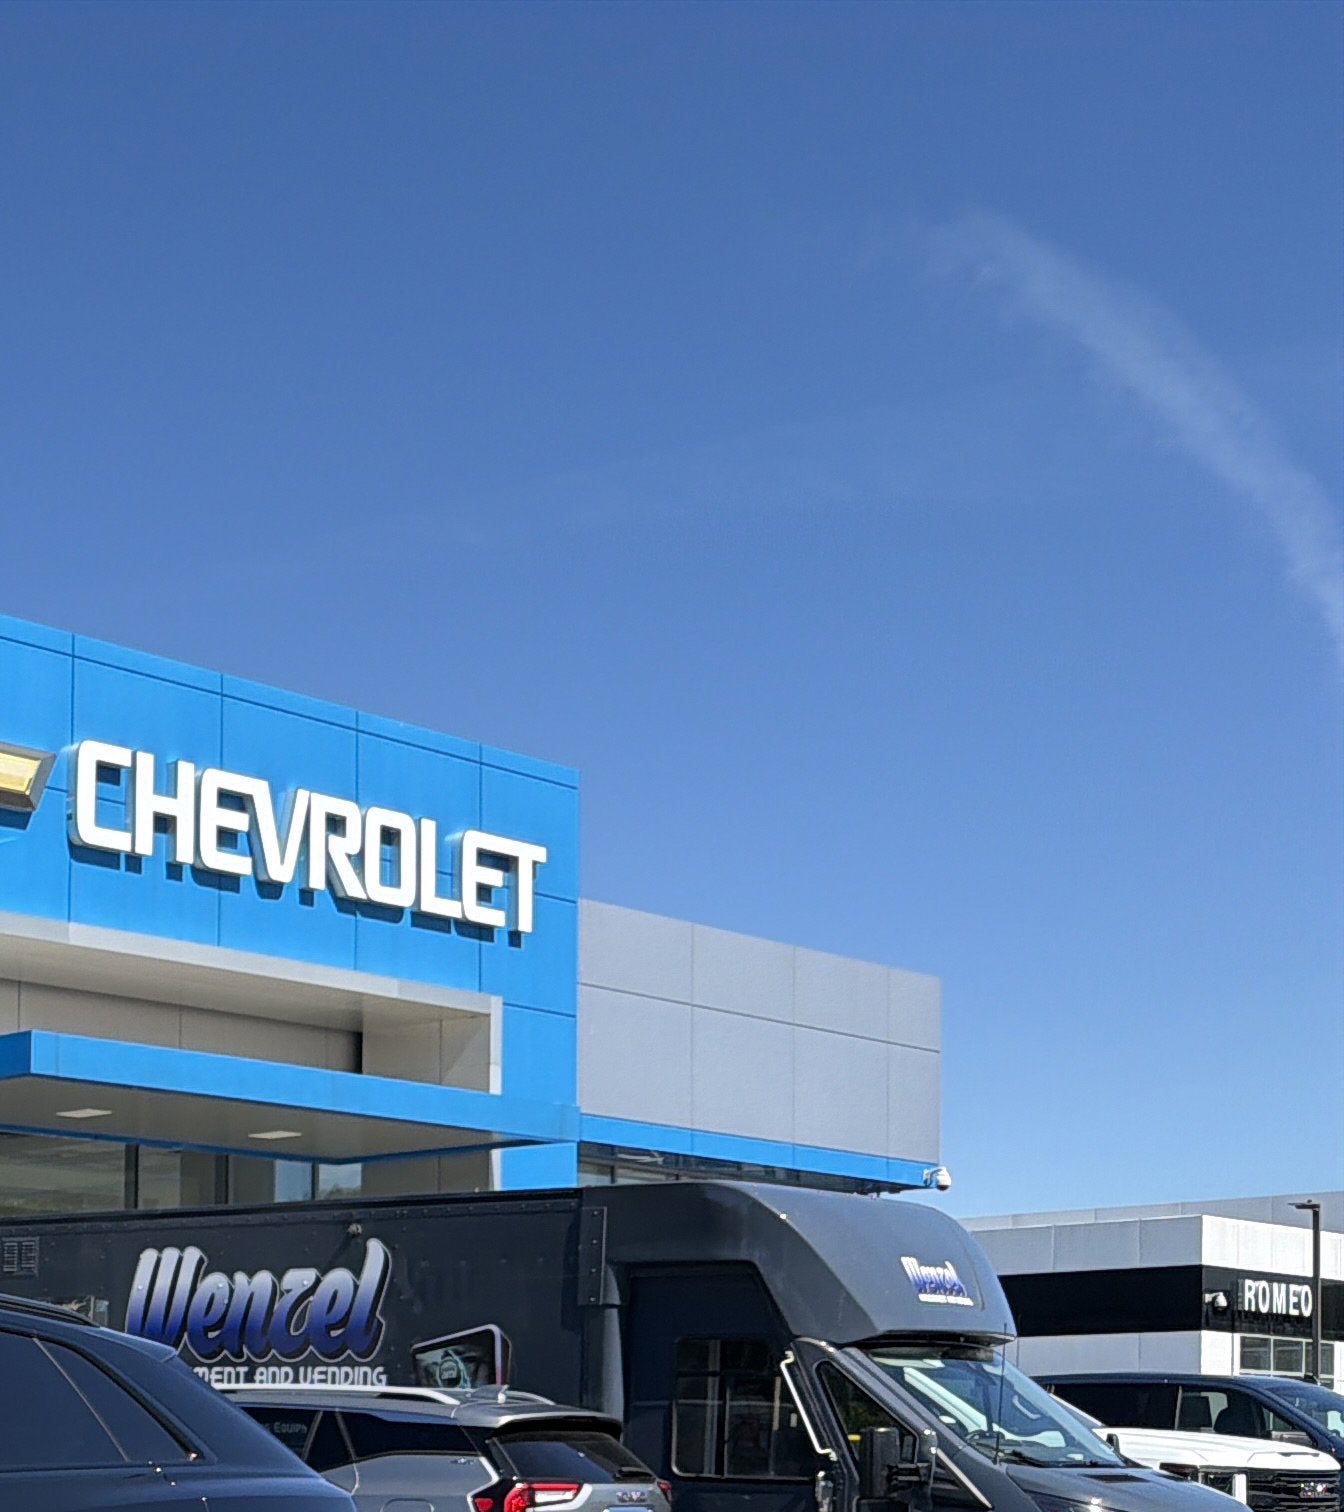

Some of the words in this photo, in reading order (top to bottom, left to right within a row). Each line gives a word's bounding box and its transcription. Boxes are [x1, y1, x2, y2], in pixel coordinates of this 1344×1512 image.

[72, 738, 548, 934] CHEVROLET
[899, 1256, 968, 1297] Wenzel
[124, 1238, 393, 1363] Wenzel
[1244, 1278, 1312, 1317] ROMEO
[253, 1366, 294, 1385] AND
[298, 1366, 387, 1387] VENDING
